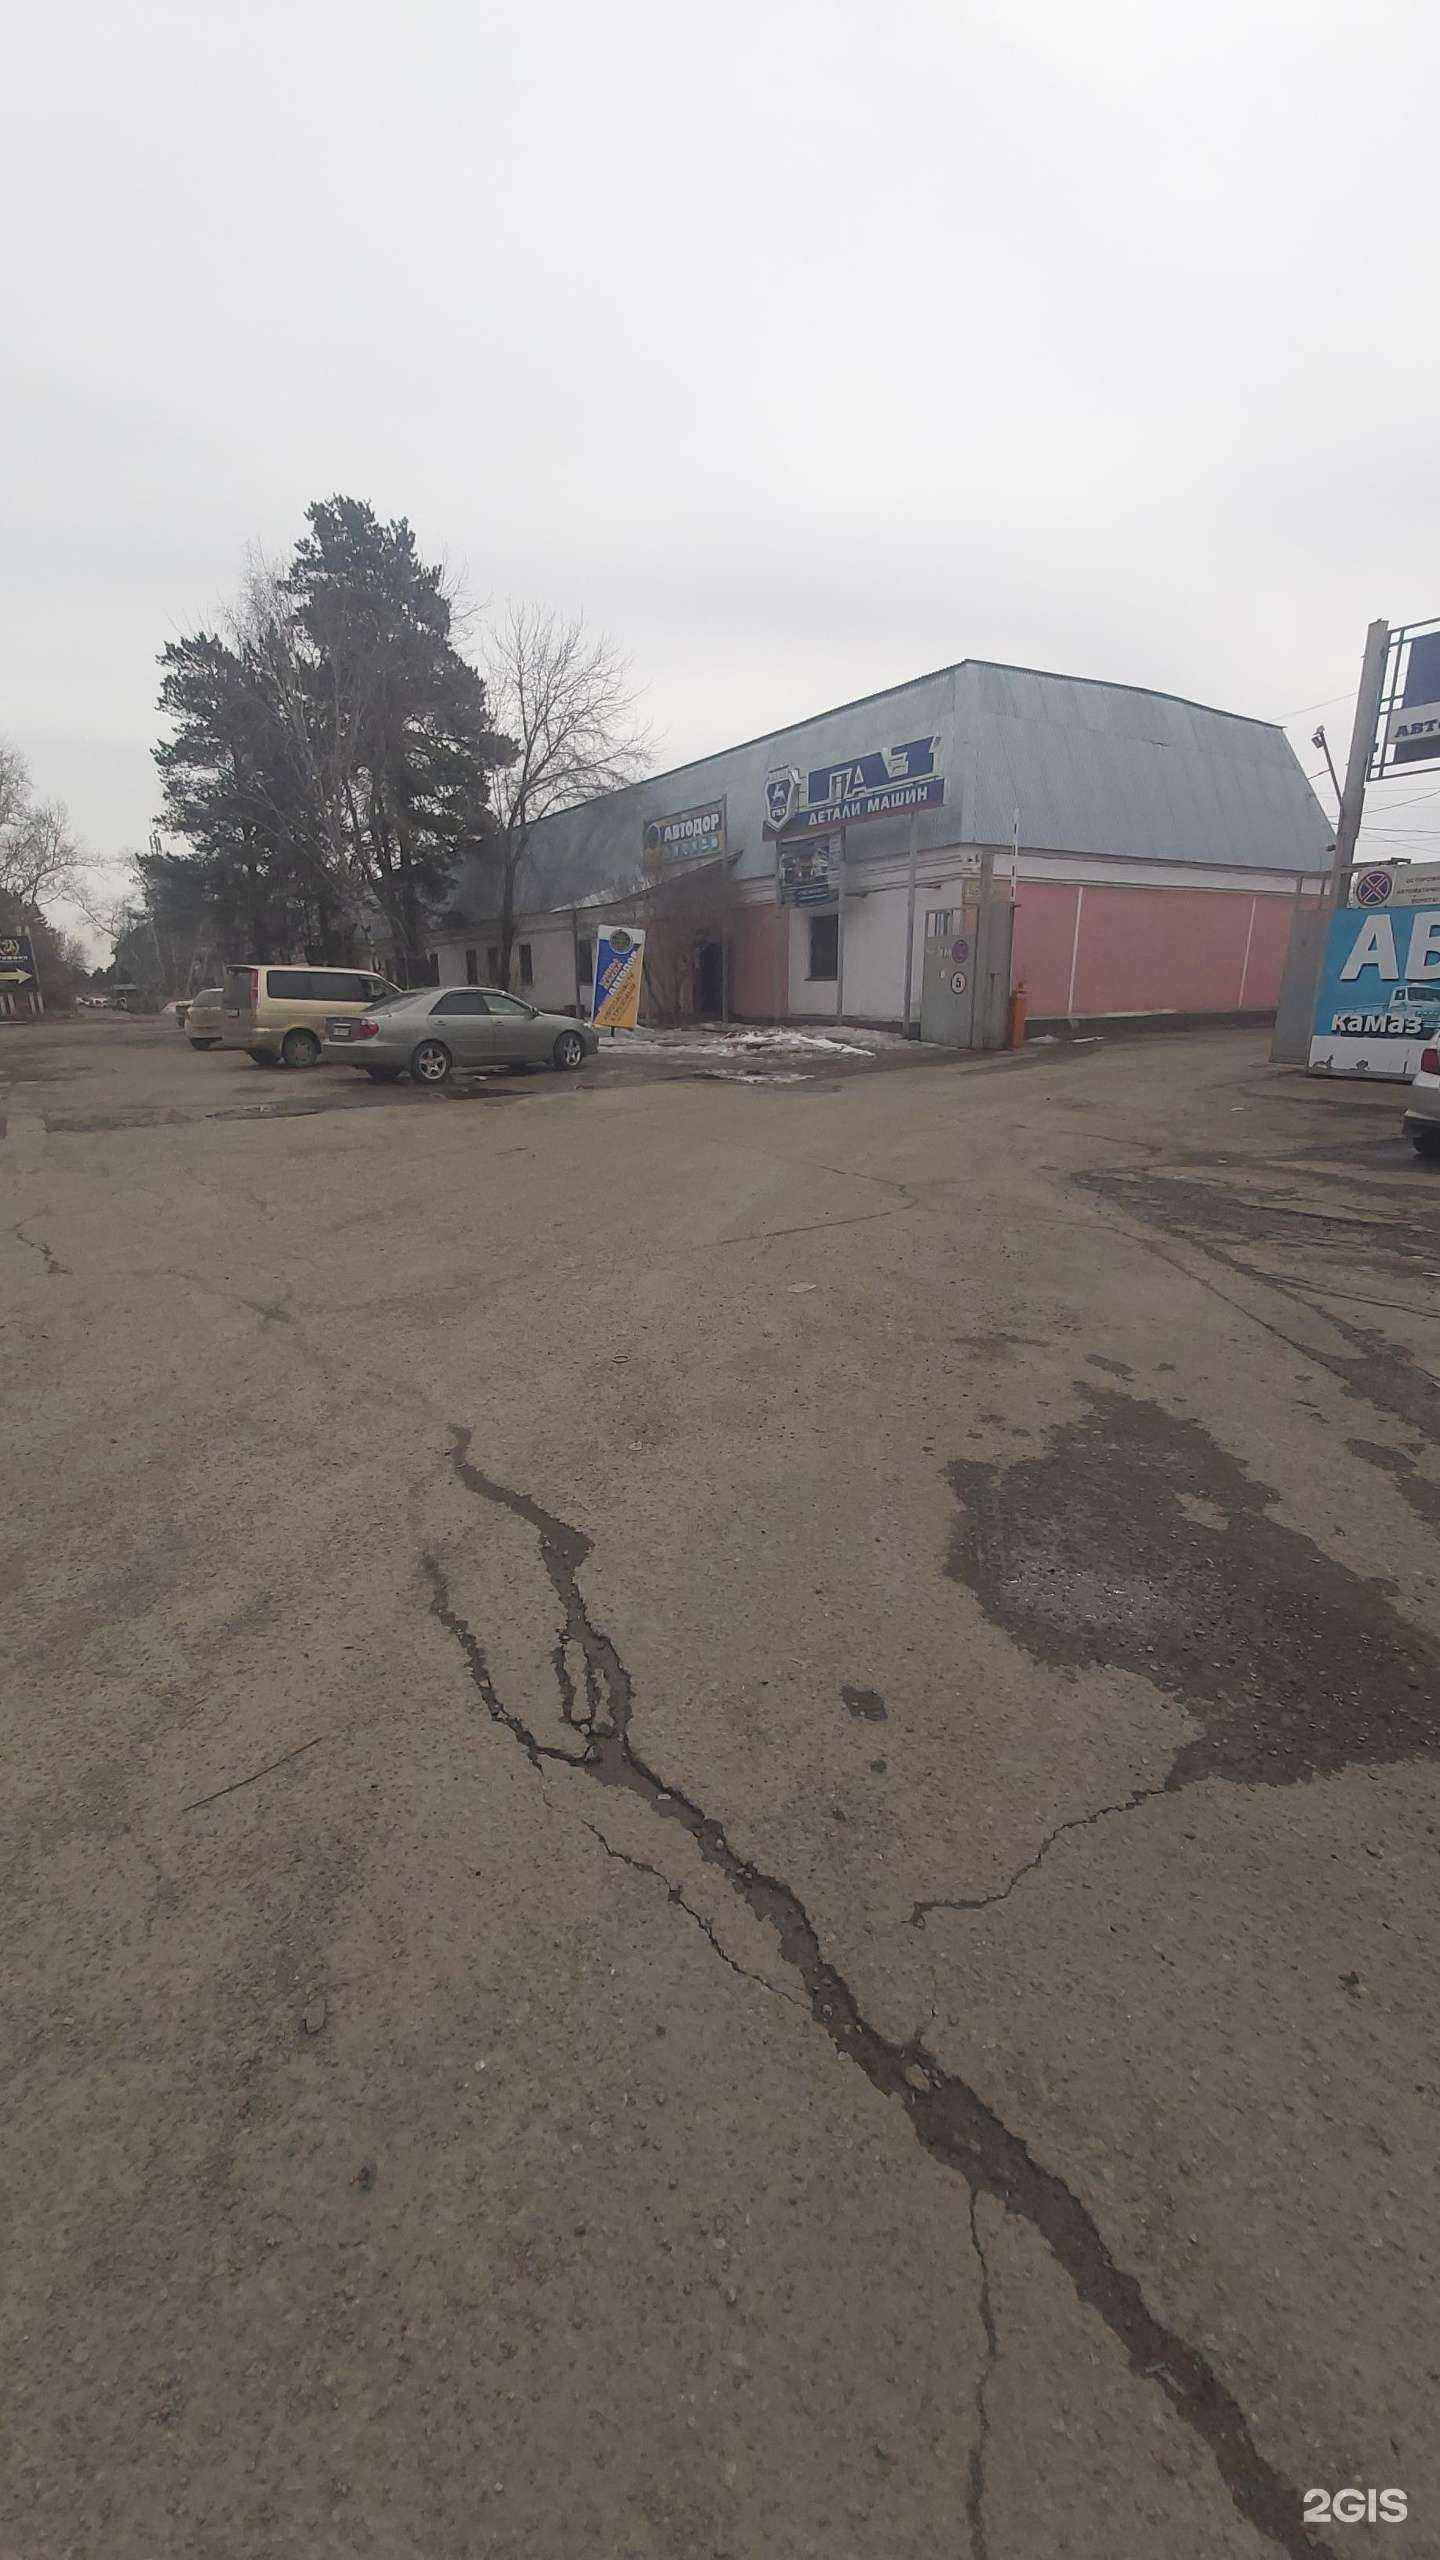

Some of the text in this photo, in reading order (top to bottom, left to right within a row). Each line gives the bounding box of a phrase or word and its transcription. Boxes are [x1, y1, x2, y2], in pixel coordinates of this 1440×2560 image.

[1394, 718, 1440, 738] АВТ
[808, 786, 928, 826] ДЕТАЛИ МАШИН
[955, 977, 962, 989] 5
[1331, 1013, 1422, 1034] камаз
